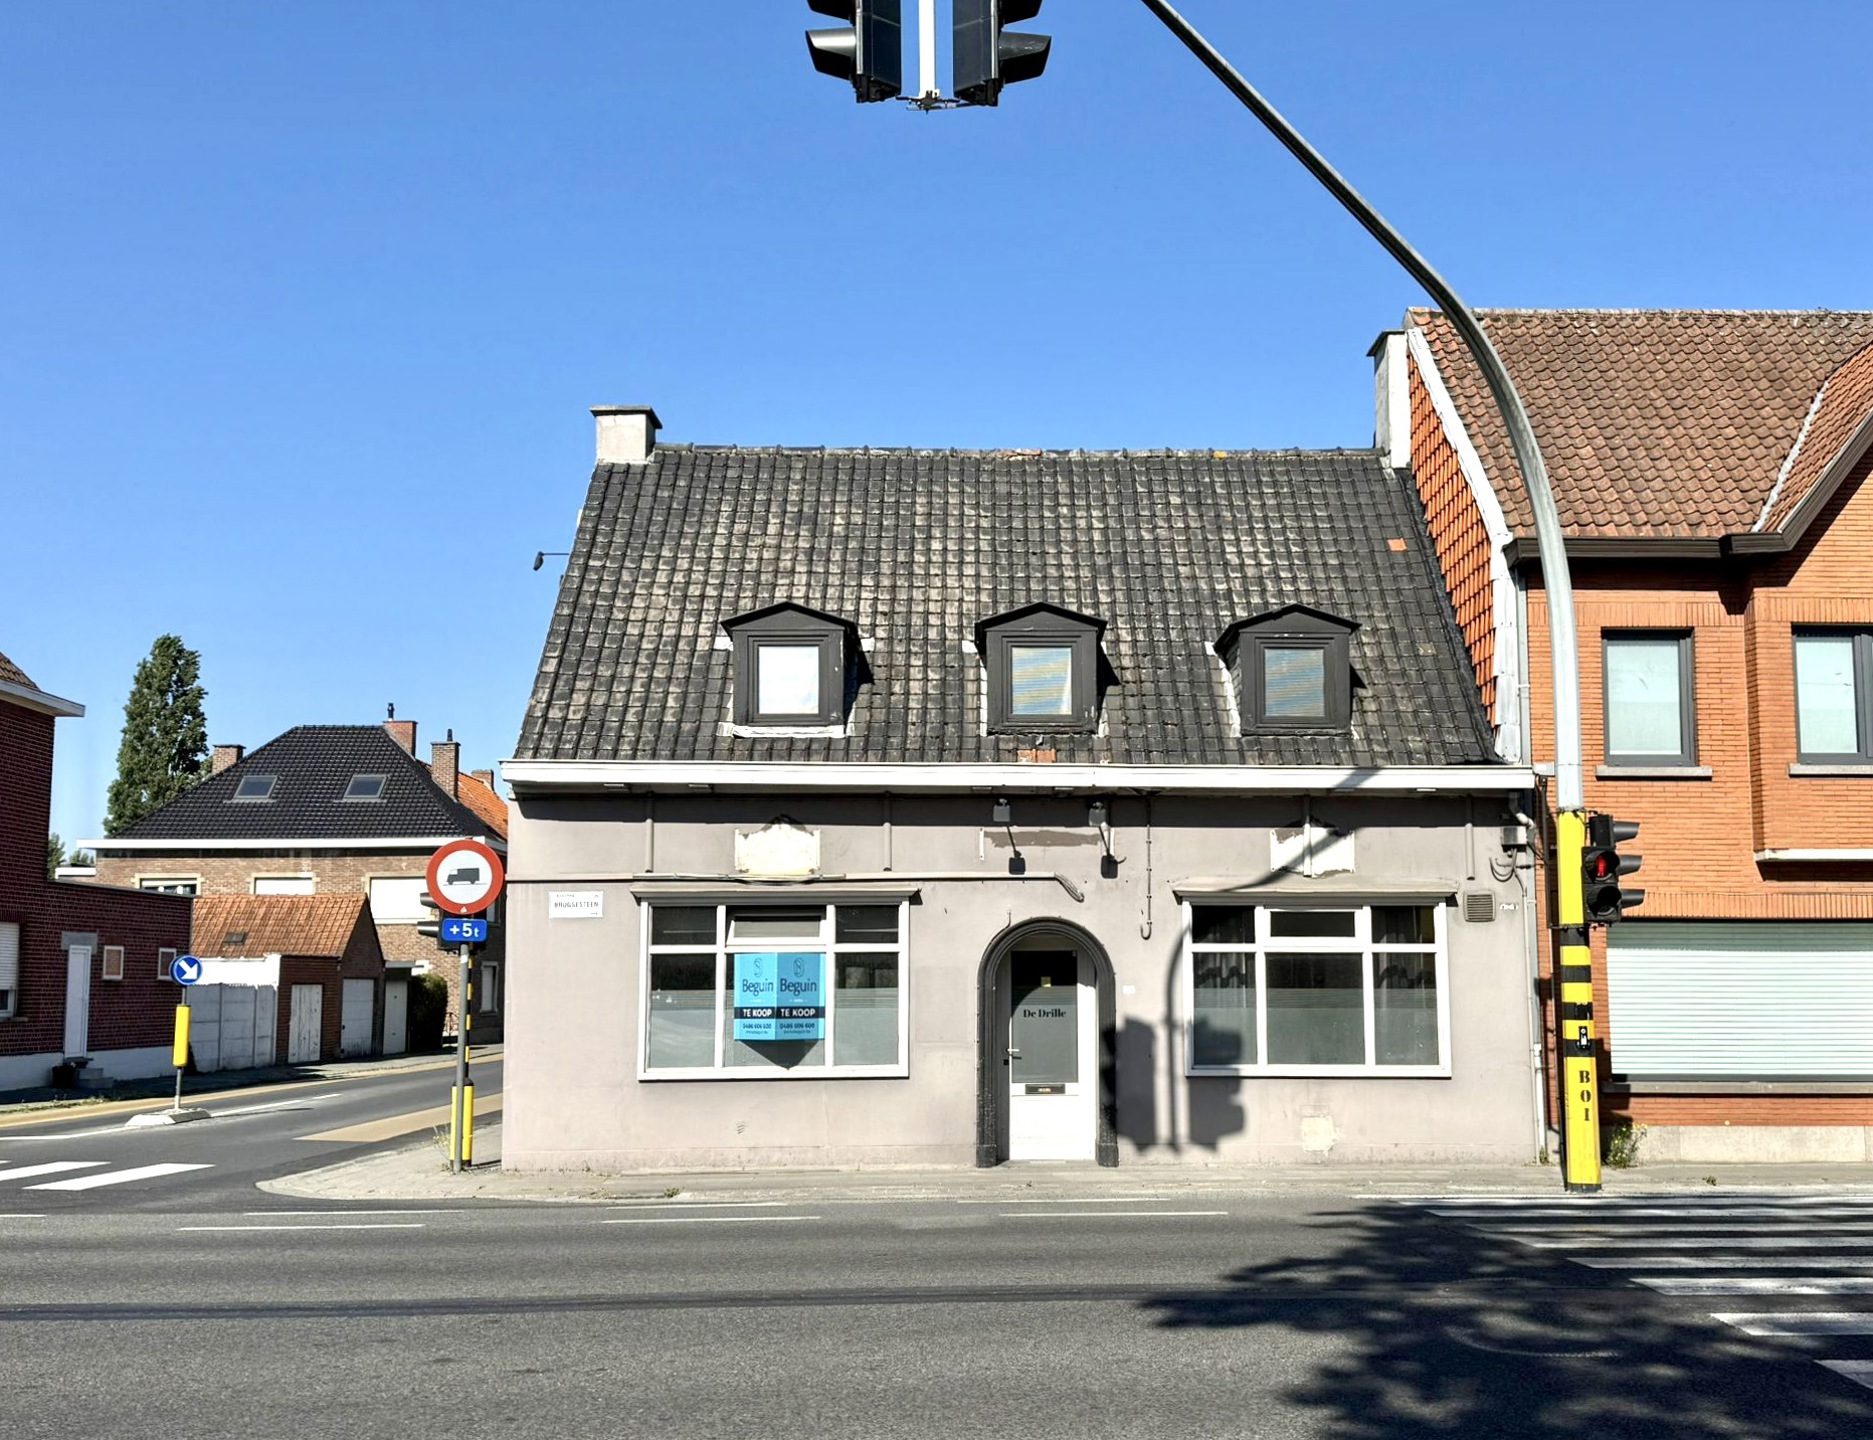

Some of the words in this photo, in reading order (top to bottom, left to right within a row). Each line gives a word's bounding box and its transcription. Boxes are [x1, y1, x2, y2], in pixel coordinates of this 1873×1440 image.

[742, 978, 774, 997] Beguin
[780, 978, 817, 997] Beguin
[743, 1009, 751, 1017] TE
[752, 1009, 772, 1017] KOOP
[780, 1009, 790, 1017] TE
[792, 1009, 816, 1017] KOOP
[1023, 1009, 1037, 1018] De
[1038, 1008, 1067, 1018] Drille
